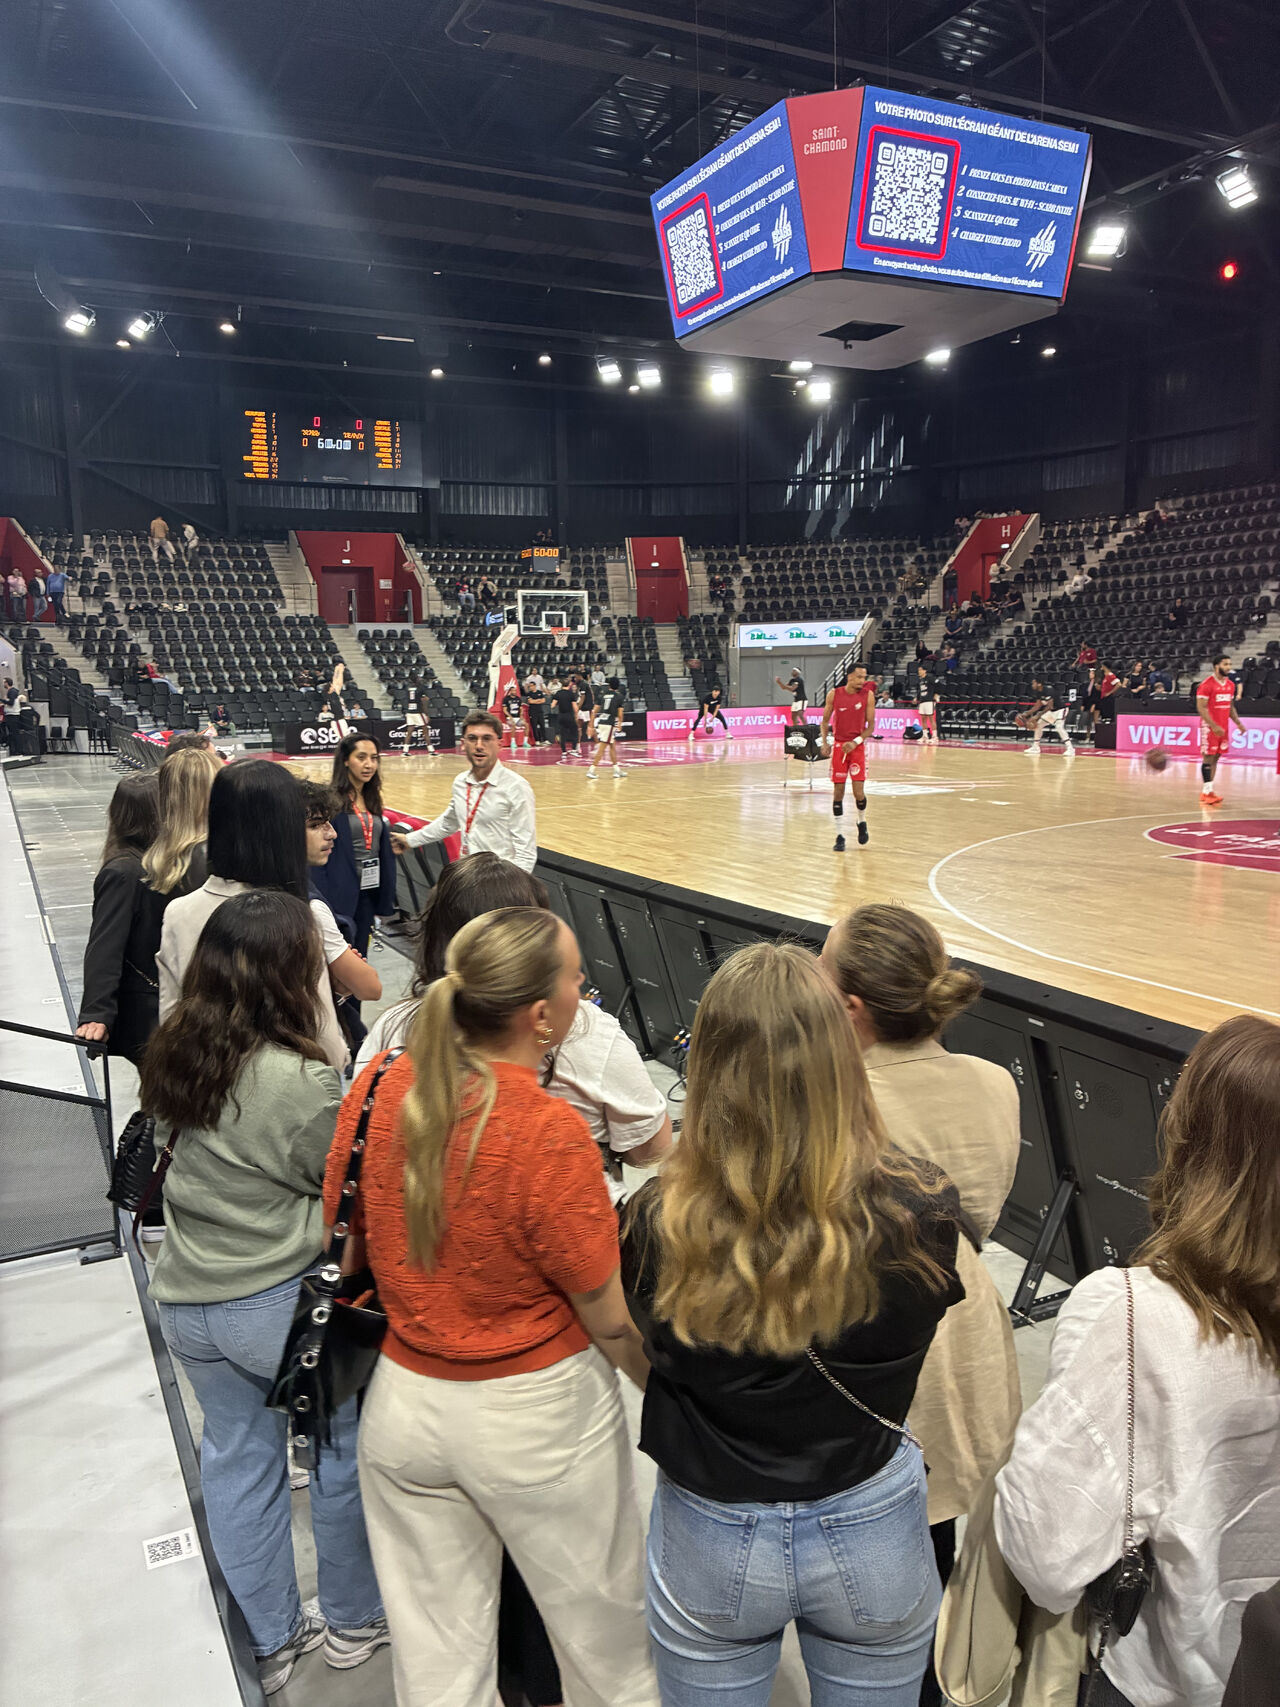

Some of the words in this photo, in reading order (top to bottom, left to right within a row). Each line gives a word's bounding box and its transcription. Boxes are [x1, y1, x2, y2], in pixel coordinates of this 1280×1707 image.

[874, 100, 905, 118] VOTRE
[904, 106, 935, 124] PHOTO
[934, 113, 955, 128] SUR
[953, 115, 988, 135] L'ÉCRAN
[987, 122, 1016, 141] GÉANT
[1014, 130, 1027, 143] DE
[1026, 132, 1059, 150] L'ARENA
[803, 138, 848, 155] CHAMOND
[960, 164, 968, 176] 1
[956, 185, 966, 197] 2
[951, 227, 960, 238] 4
[313, 416, 321, 427] 0
[356, 419, 363, 430] 0
[302, 437, 309, 448] 0
[358, 441, 365, 451] 0
[1002, 524, 1011, 537] H
[342, 540, 351, 552] J
[533, 547, 559, 557] 60:00
[652, 719, 687, 730] VIVEZ
[743, 715, 772, 726] AVEC
[773, 714, 787, 725] LA
[878, 717, 904, 730] AVEC
[1128, 725, 1191, 746] VIVEZ
